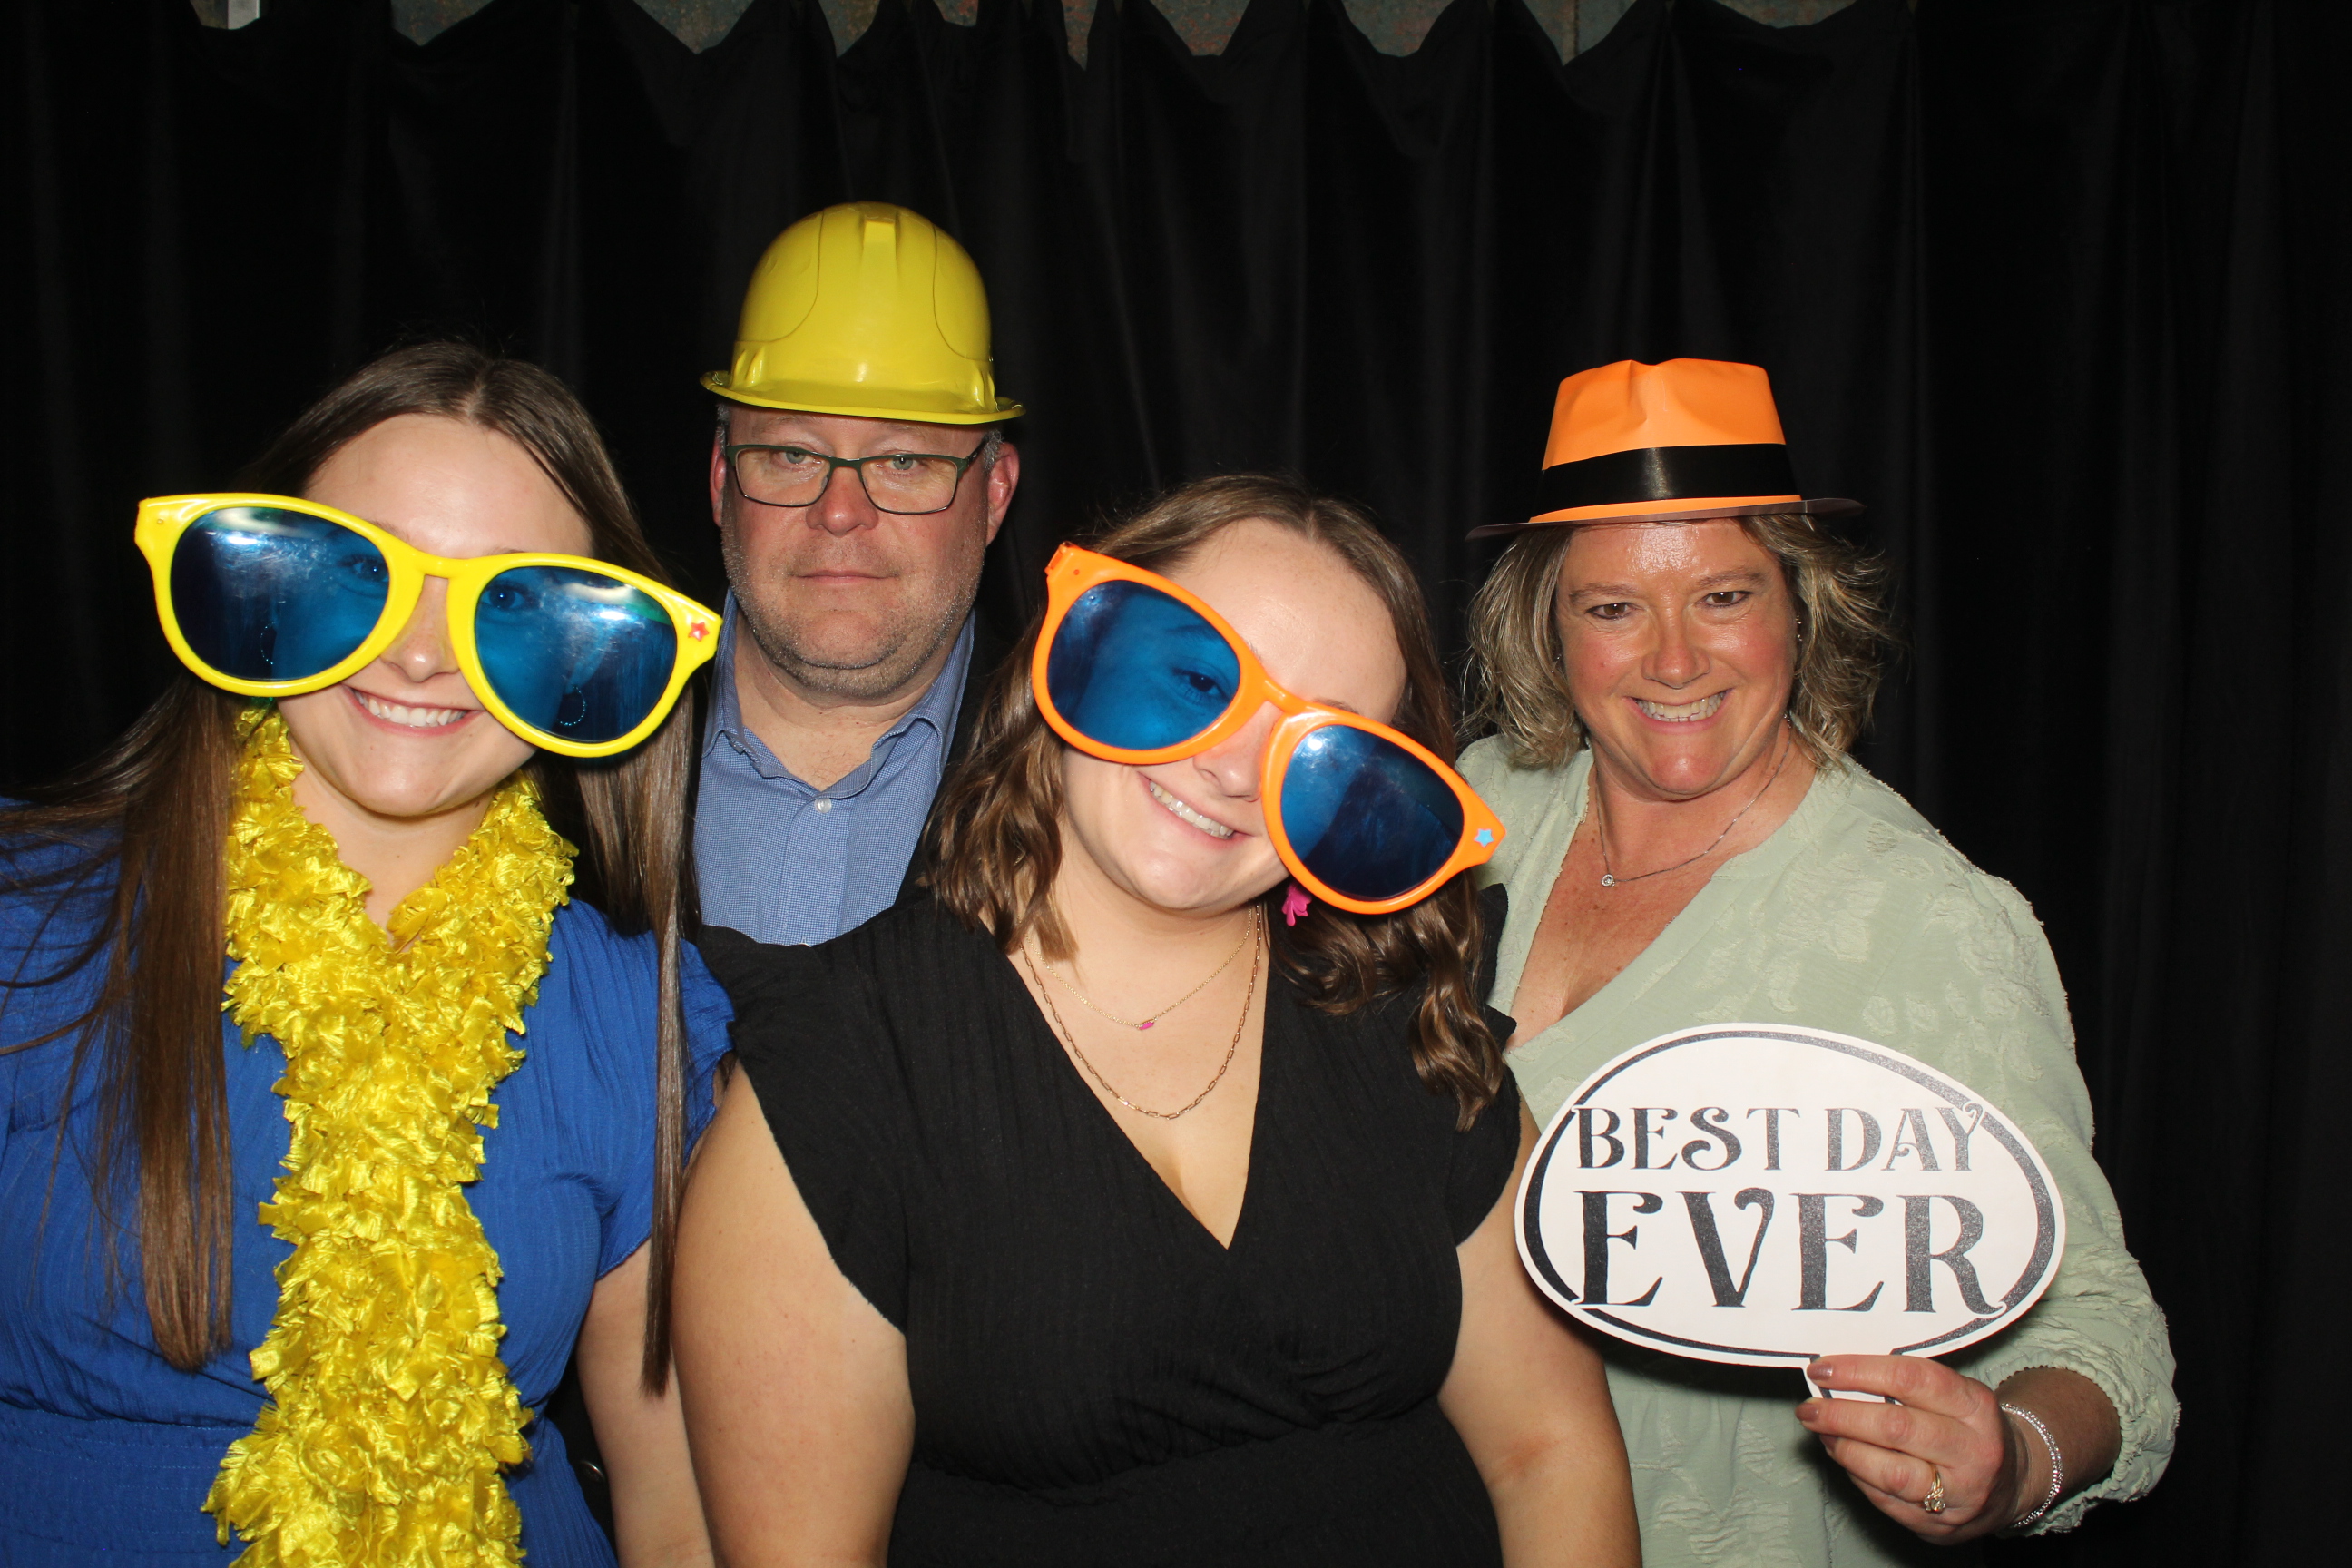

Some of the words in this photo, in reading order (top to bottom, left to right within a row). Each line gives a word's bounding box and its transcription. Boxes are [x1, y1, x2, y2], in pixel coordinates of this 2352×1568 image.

[1575, 1106, 1799, 1171] BEST
[1824, 1101, 1984, 1171] DAY
[1573, 1187, 2007, 1314] EVER
